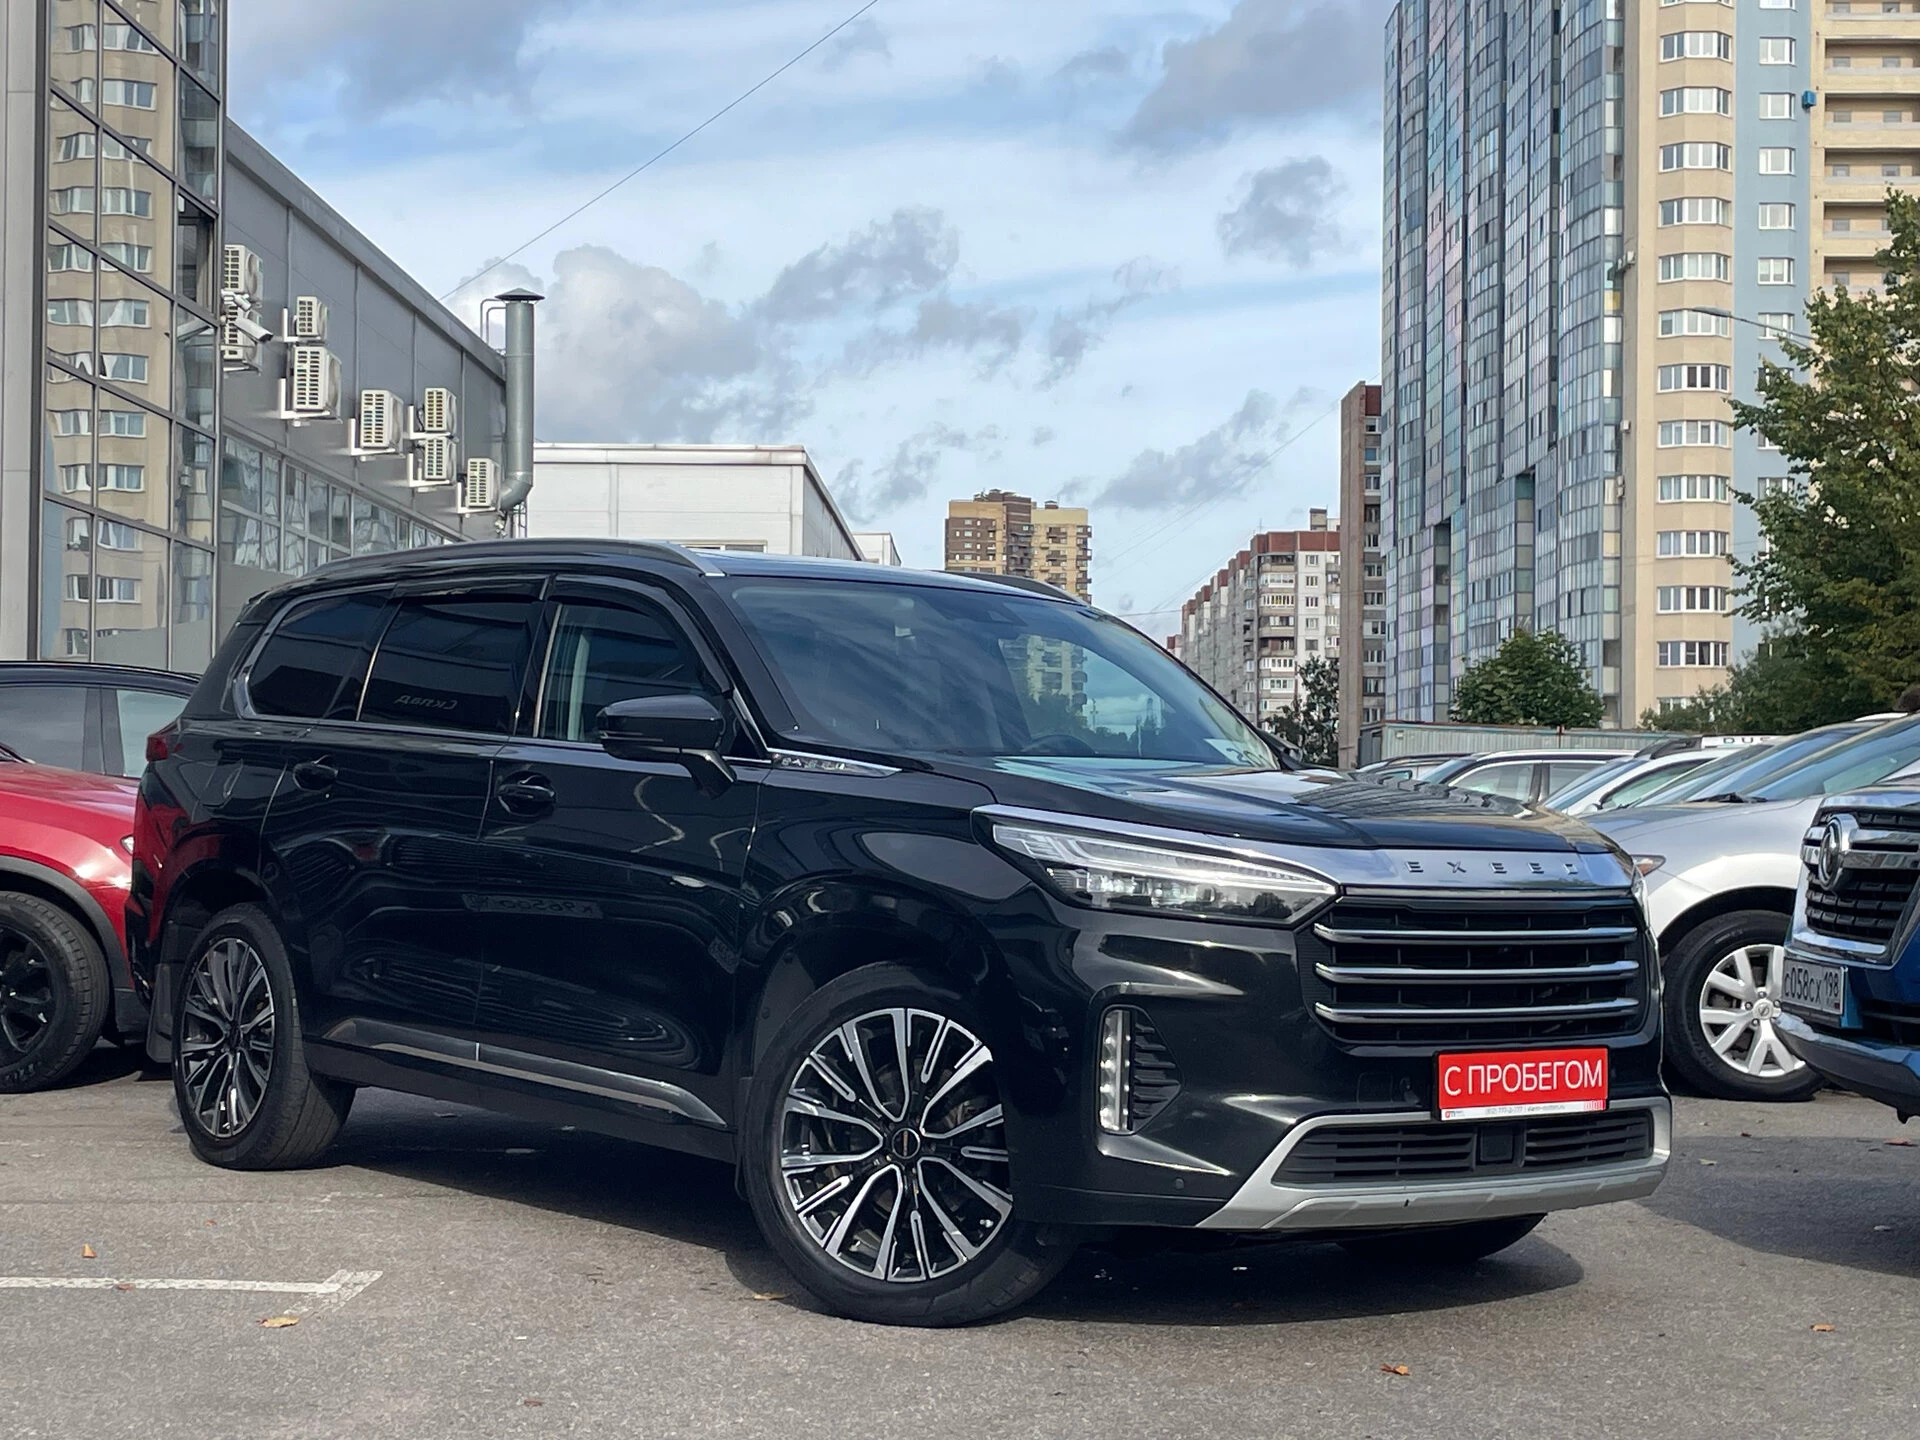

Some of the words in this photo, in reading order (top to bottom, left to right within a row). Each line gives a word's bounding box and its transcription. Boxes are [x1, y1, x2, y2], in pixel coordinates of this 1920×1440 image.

[1404, 860, 1579, 875] EXEED
[1784, 966, 1821, 1003] С058СХ
[1824, 971, 1839, 997] 198
[1444, 1066, 1461, 1096] С
[1468, 1059, 1603, 1095] ПРОБЕГОМ
